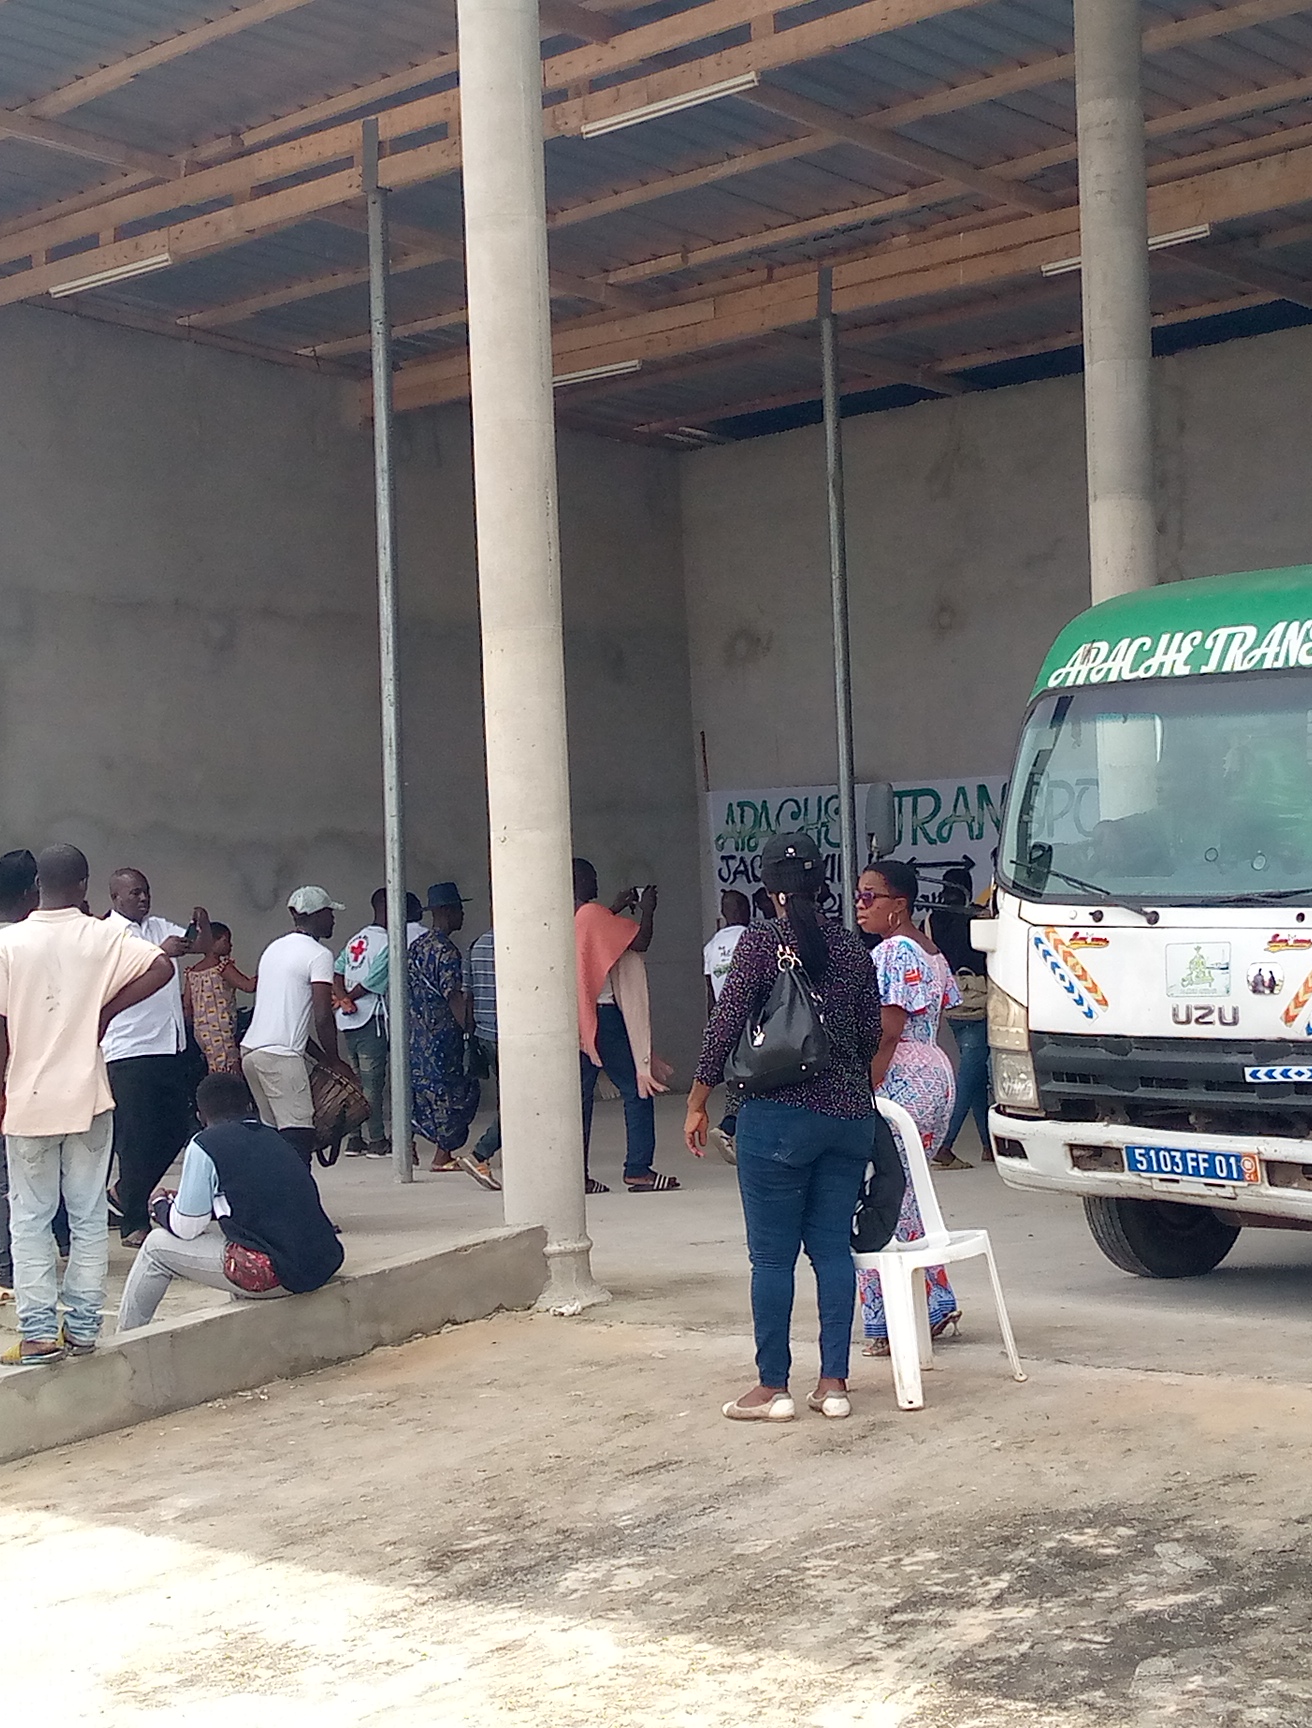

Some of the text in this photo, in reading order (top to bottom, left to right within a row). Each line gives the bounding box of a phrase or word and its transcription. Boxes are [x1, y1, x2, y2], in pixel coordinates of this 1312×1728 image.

[1048, 630, 1204, 687] APACHE
[1171, 1004, 1239, 1027] UZU
[1134, 1148, 1238, 1179] 5103 FF 01
